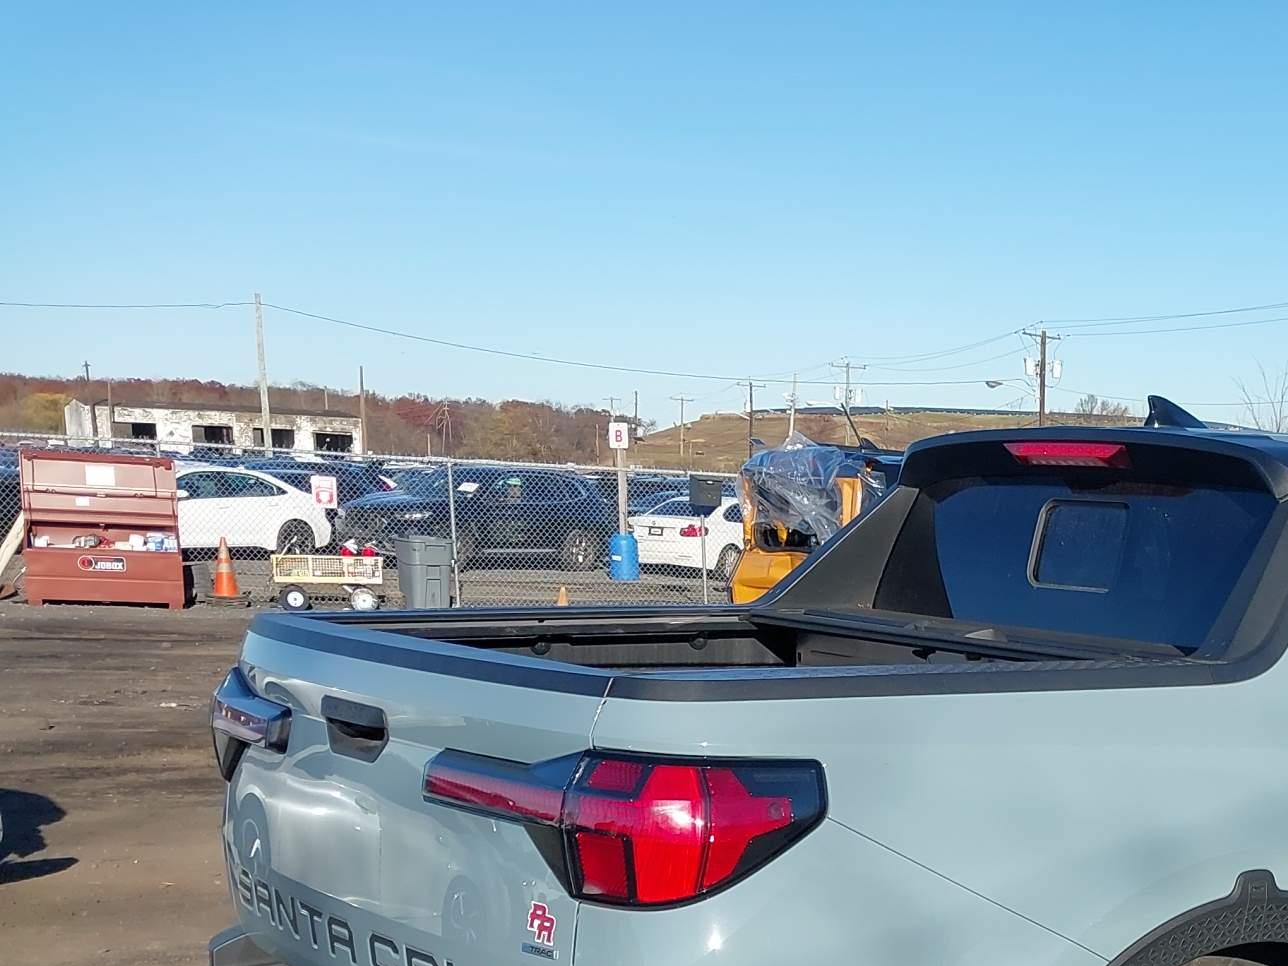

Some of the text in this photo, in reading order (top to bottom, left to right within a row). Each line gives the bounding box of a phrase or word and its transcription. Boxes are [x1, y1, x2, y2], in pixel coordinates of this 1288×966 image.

[615, 429, 623, 442] B
[95, 561, 123, 570] JOBOX
[236, 867, 358, 966] SANTA
